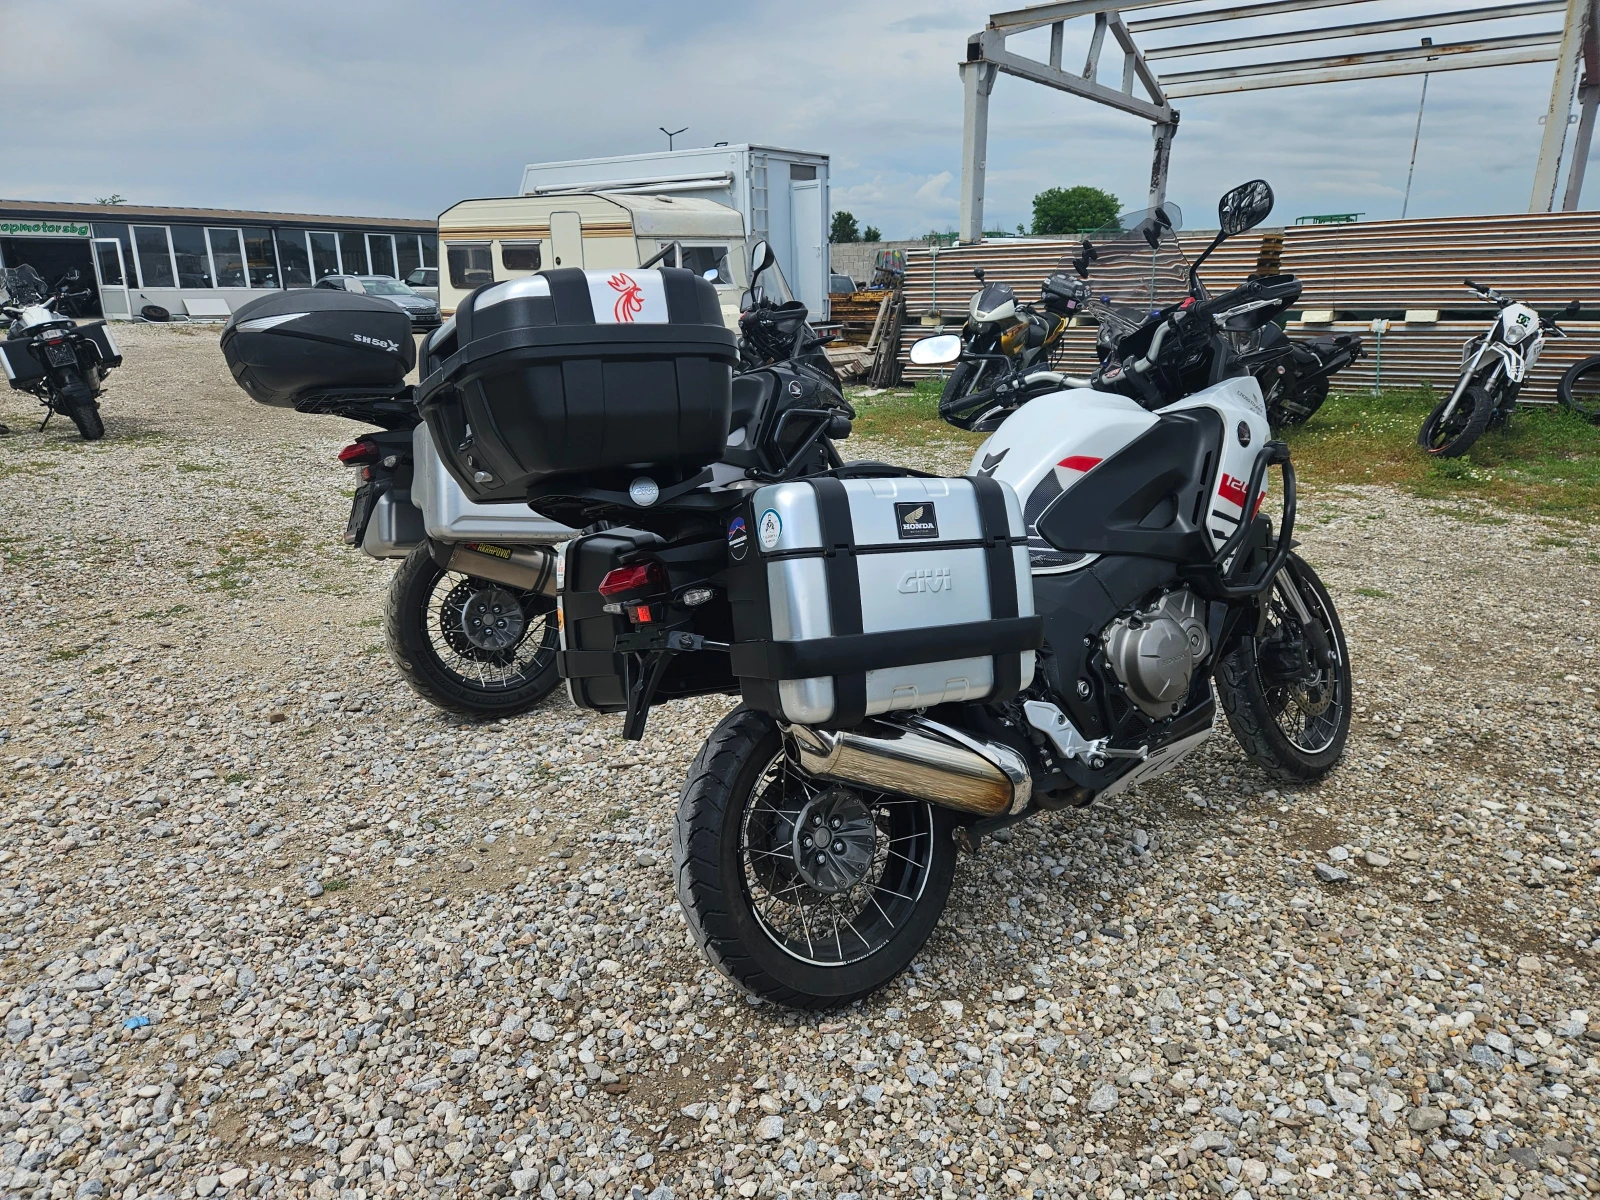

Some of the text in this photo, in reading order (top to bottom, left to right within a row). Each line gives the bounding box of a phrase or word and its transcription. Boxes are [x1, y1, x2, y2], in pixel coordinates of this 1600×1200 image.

[0, 222, 88, 236] opmotorsbg
[353, 334, 400, 352] SH58X
[897, 567, 952, 594] GIVI
